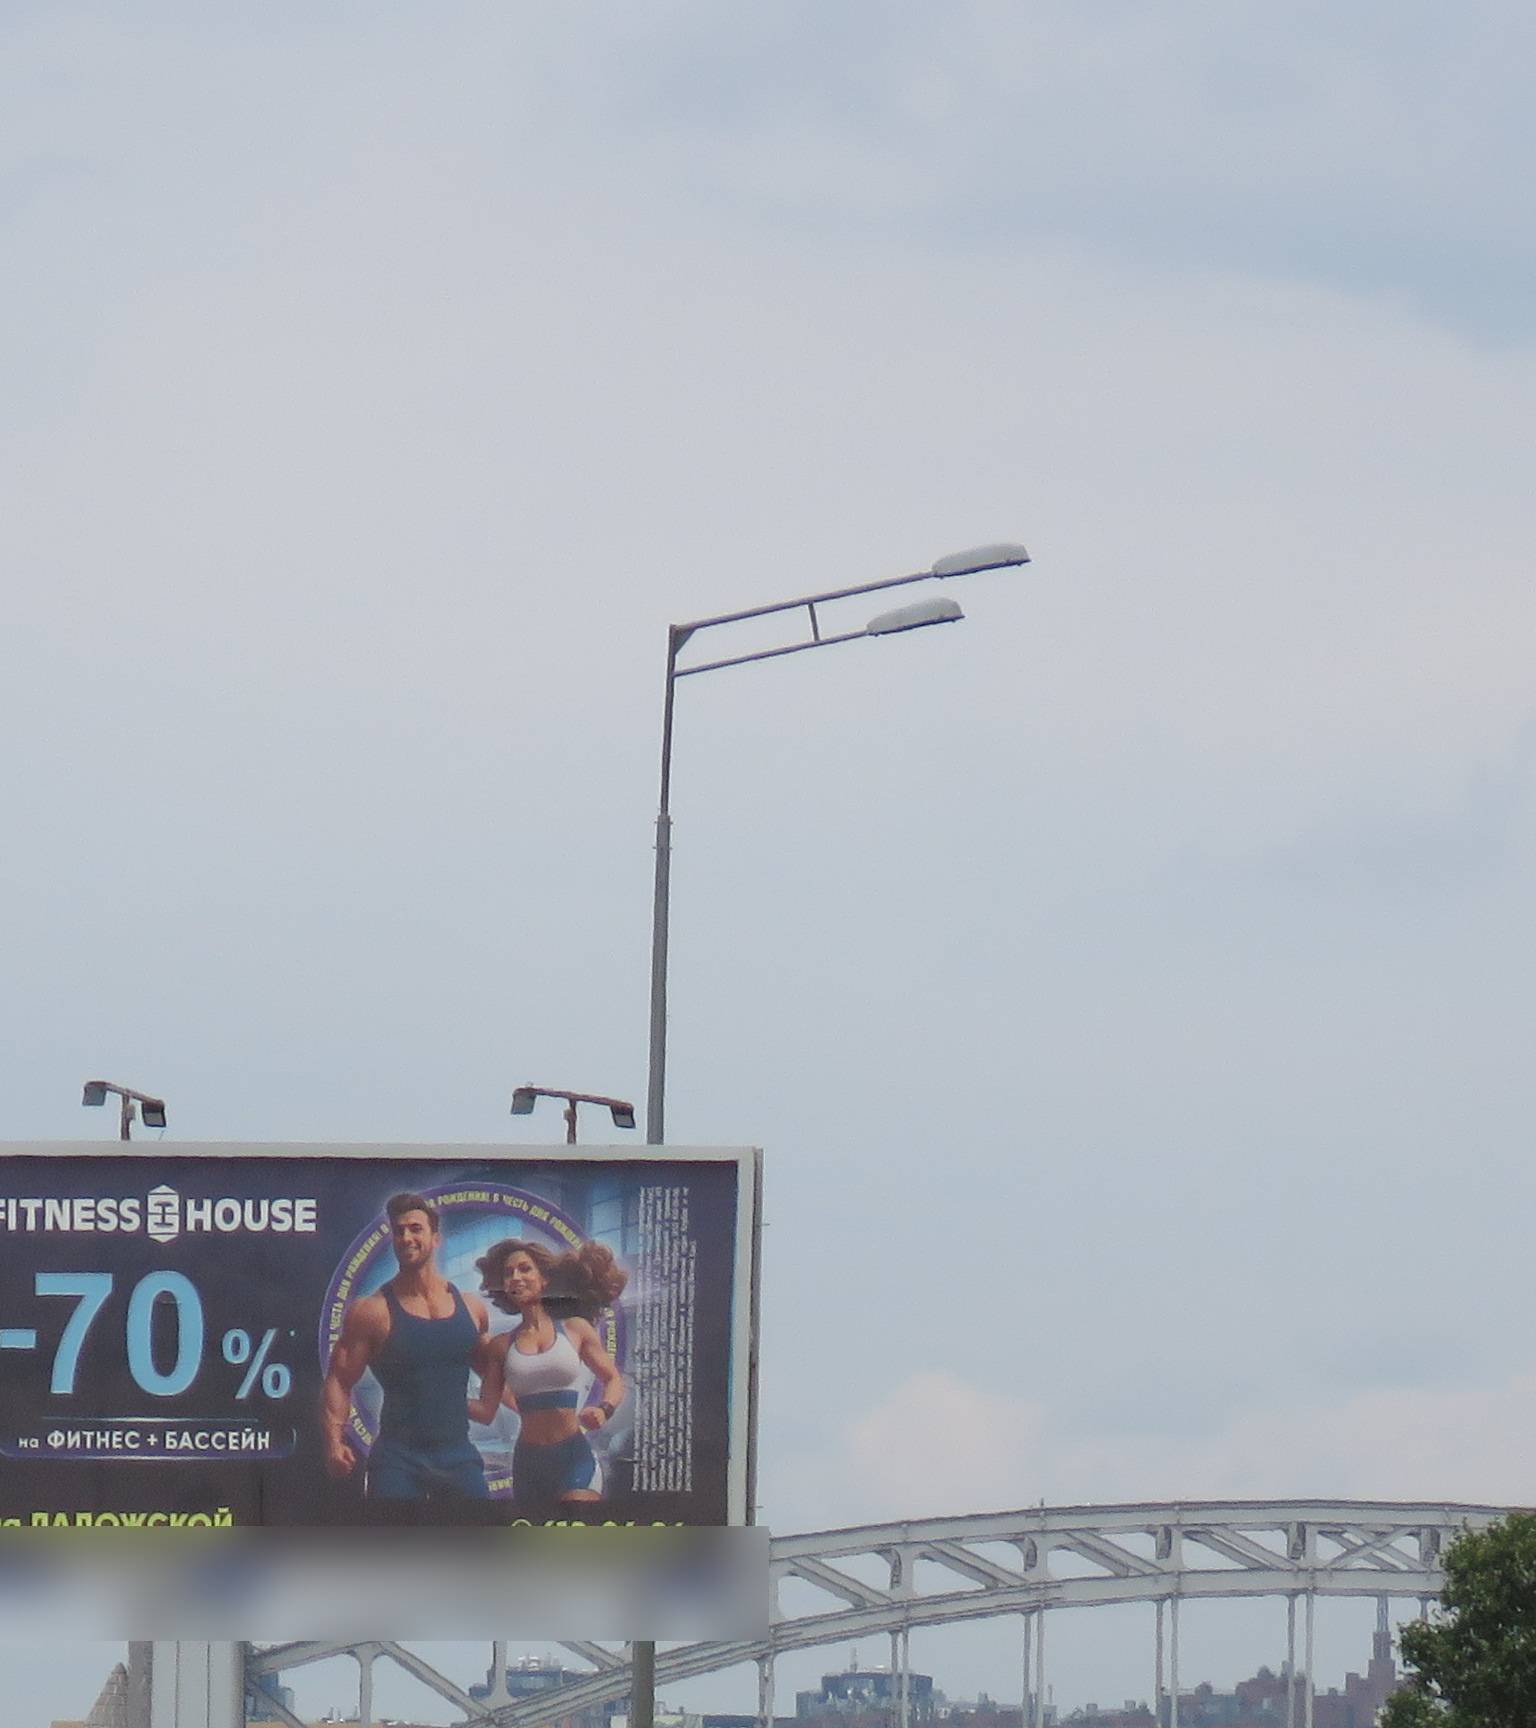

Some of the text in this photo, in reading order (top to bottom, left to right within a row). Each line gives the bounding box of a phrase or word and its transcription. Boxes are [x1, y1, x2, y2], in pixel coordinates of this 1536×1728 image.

[186, 1198, 317, 1232] HOUSE
[18, 1437, 40, 1449] на
[46, 1429, 140, 1450] ФИТНЕС
[164, 1428, 270, 1451] БАССЕЙН
